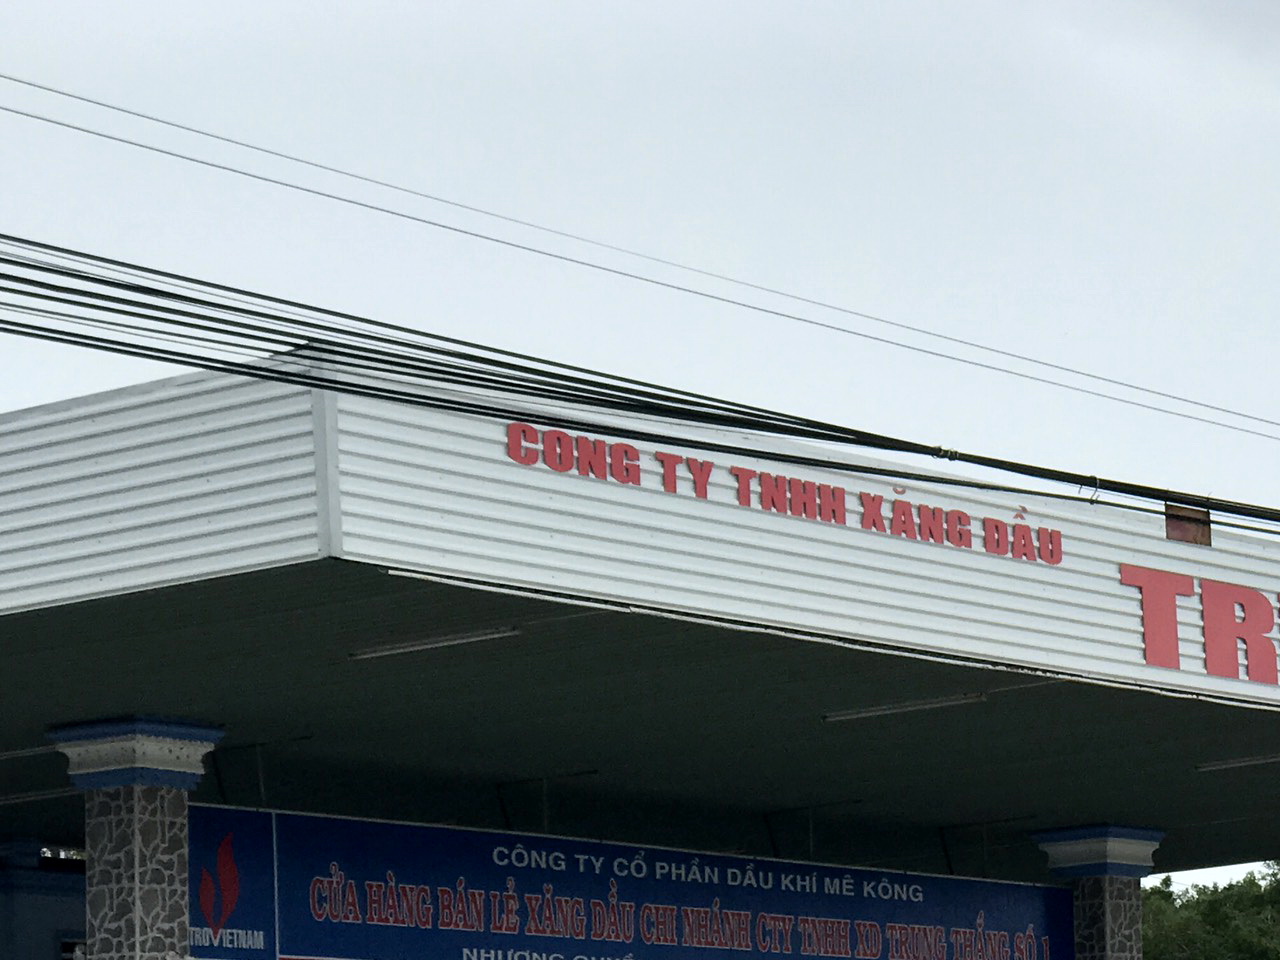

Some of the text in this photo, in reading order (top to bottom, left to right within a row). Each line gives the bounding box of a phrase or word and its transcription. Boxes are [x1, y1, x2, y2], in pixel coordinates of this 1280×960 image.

[655, 450, 715, 500] TY
[730, 465, 846, 525] TNHH
[860, 487, 972, 549] XĂNG
[983, 505, 1063, 565] DẦU
[310, 861, 362, 924] CỬA
[365, 870, 433, 929] HÀNG
[437, 876, 485, 933] BÁN
[490, 876, 520, 935] LẺ
[524, 883, 586, 940] XĂNG
[590, 878, 635, 944] DẦU
[640, 903, 678, 946] CHI
[681, 896, 752, 951] NHÁNH
[756, 912, 795, 954] CTY
[798, 915, 852, 958] TNHH
[854, 920, 881, 960] XD
[492, 843, 924, 902] CÔNG TY CỔ PHẦN DẦU KHÍ MÊ KÔNG
[188, 927, 264, 950] TROVIETNAM
